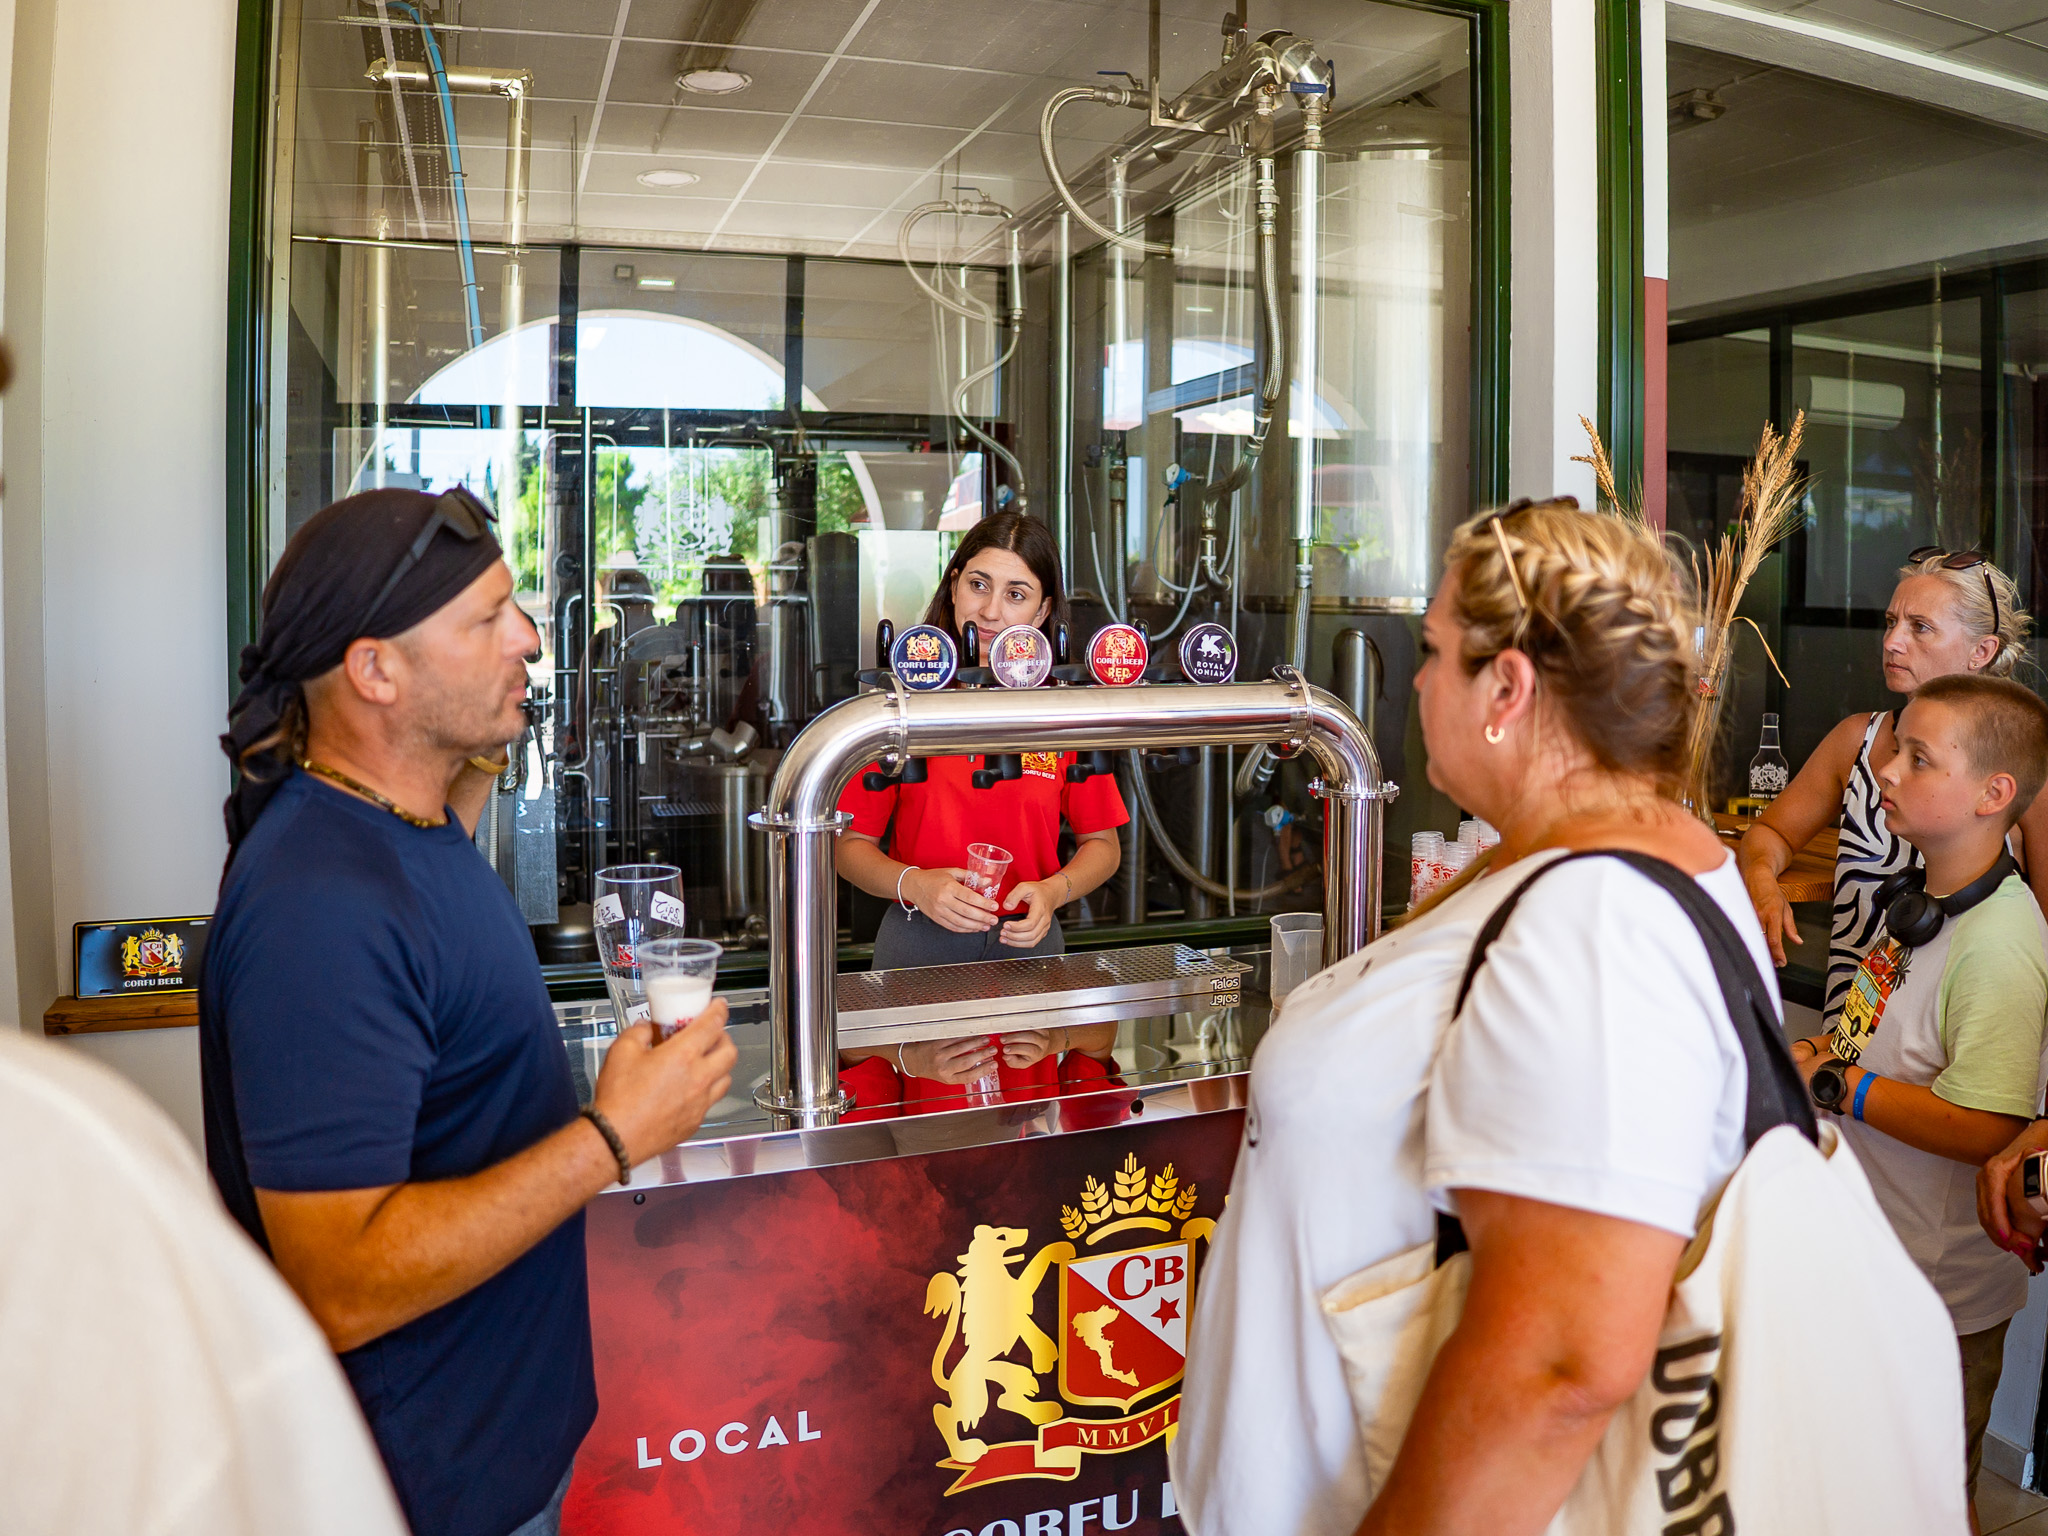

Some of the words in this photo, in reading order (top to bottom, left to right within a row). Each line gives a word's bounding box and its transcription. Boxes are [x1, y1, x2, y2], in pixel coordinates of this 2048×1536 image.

[897, 661, 926, 669] CORFU
[927, 661, 950, 669] BEER
[1096, 657, 1121, 665] CORFU
[1123, 658, 1144, 666] BEER
[1196, 661, 1224, 671] ROYAL
[1108, 667, 1131, 678] RED
[1194, 668, 1225, 678] IONIAN
[906, 673, 941, 683] LAGER
[1042, 772, 1056, 780] BEER
[124, 979, 156, 988] CORFU
[157, 977, 183, 986] BEER
[1210, 977, 1239, 991] Talos
[1107, 1255, 1184, 1301] CB
[1077, 1407, 1171, 1446] MMVI
[636, 1410, 822, 1469] LOCAL
